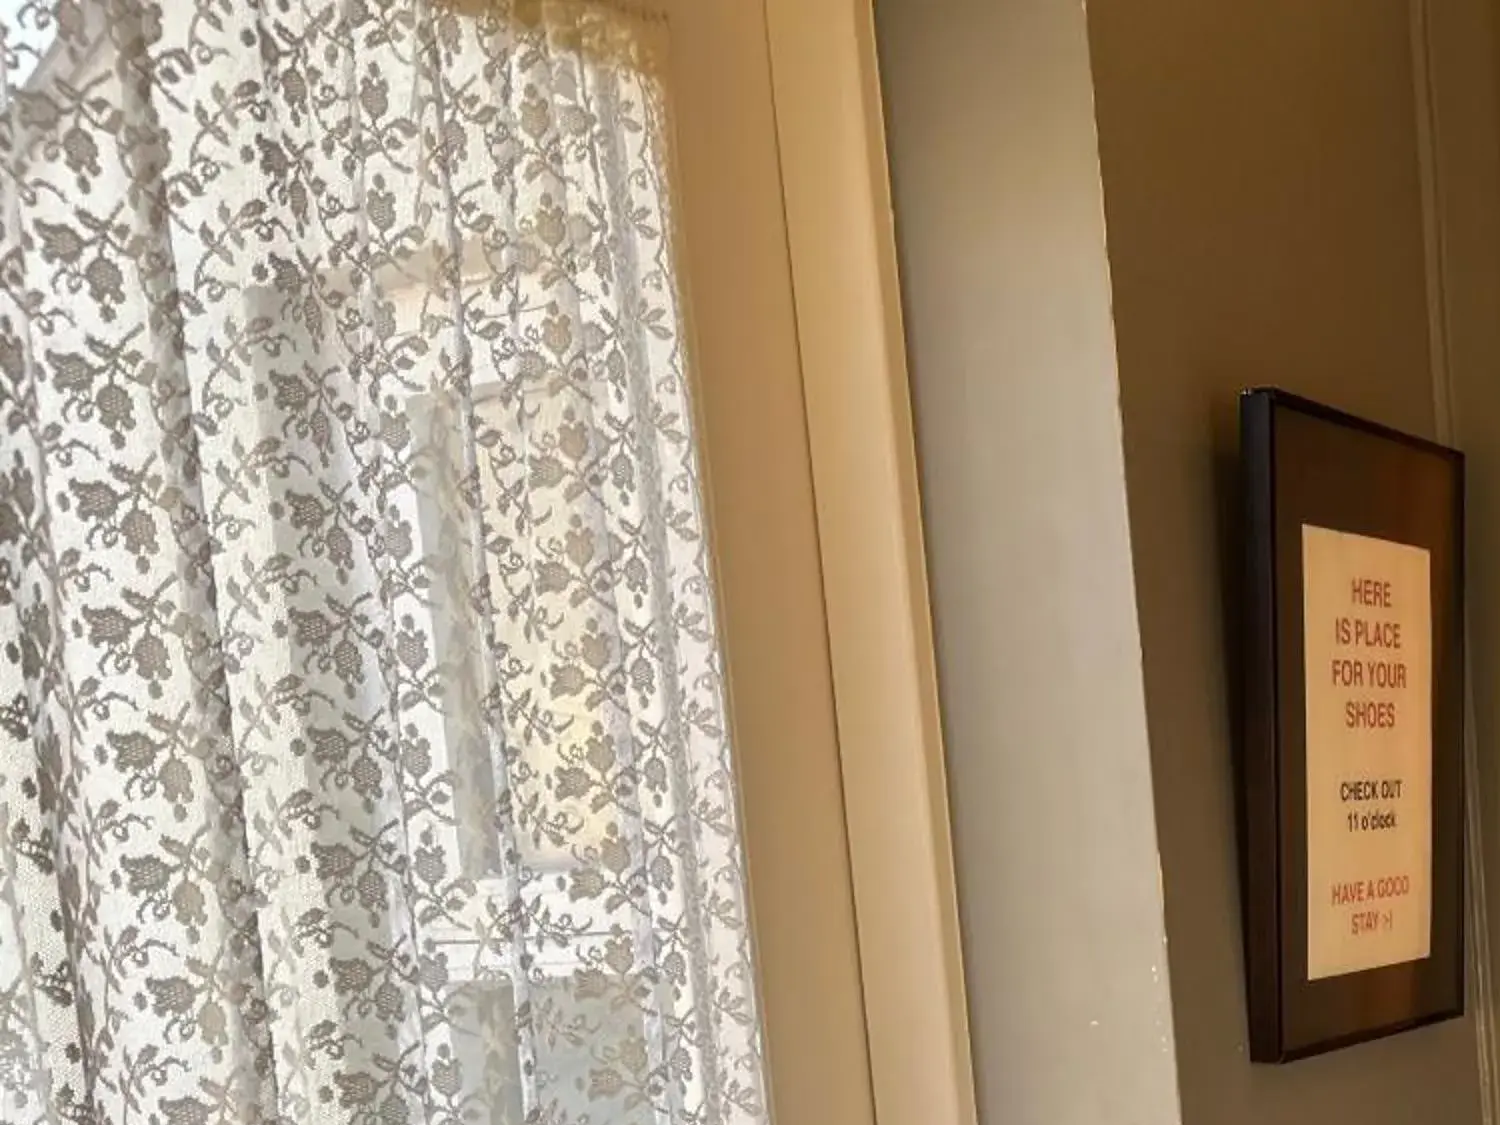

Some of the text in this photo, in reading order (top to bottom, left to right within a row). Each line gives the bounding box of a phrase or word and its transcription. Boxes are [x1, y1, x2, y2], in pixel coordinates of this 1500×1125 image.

[1351, 577, 1392, 608] HERE
[1335, 616, 1402, 649] IS PLACE
[1331, 659, 1407, 689] FOR YOUR
[1345, 701, 1396, 729] SHOES
[1340, 780, 1402, 802] CHECK OUT
[1347, 811, 1358, 832] 11
[1331, 875, 1410, 906] HAVE A GOOD
[1352, 911, 1379, 935] STAY
